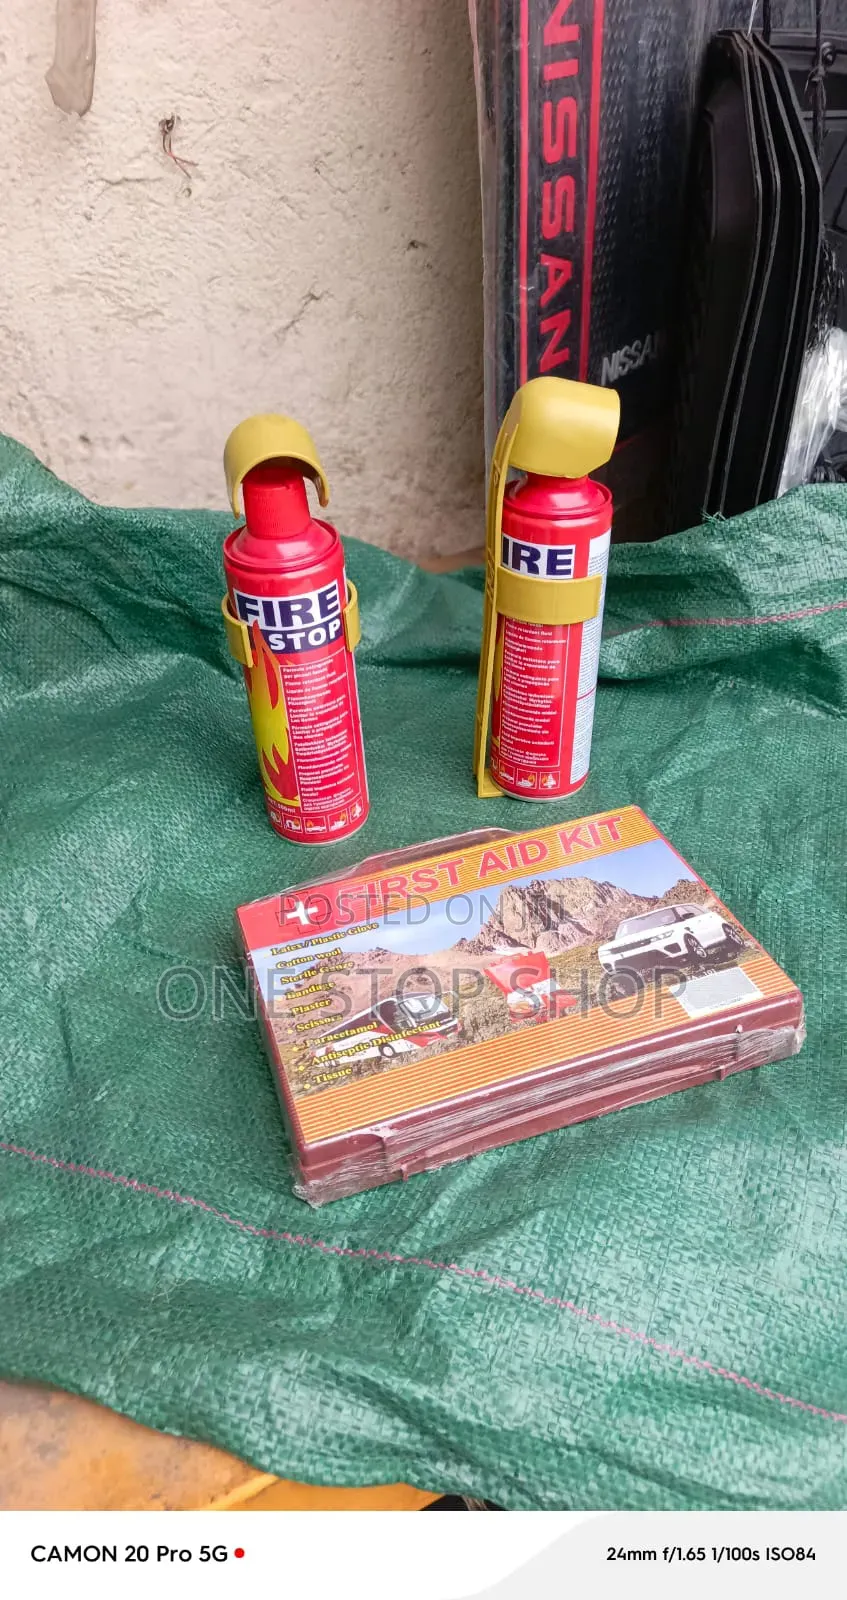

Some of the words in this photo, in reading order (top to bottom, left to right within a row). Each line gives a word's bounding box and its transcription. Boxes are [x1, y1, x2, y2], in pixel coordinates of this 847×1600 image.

[539, 0, 580, 373] NISSAN
[601, 330, 658, 386] NISSA
[502, 537, 574, 576] IRE
[235, 583, 340, 628] FIRE
[268, 618, 341, 651] STOP
[339, 859, 465, 916] FIRST
[478, 839, 548, 878] AID
[557, 816, 622, 855] KIT
[310, 930, 346, 947] Plastic
[346, 922, 379, 936] Glove
[276, 954, 314, 970] Cotton
[280, 968, 317, 985] Sterile
[285, 981, 336, 1000] Bandage
[290, 998, 331, 1016] Plaster
[295, 1014, 343, 1033] Scissors
[304, 1021, 378, 1049] Paracetamol
[312, 1041, 371, 1066] Antiseptic
[370, 1020, 442, 1047] Disinfectant
[314, 1067, 352, 1084] Tissue
